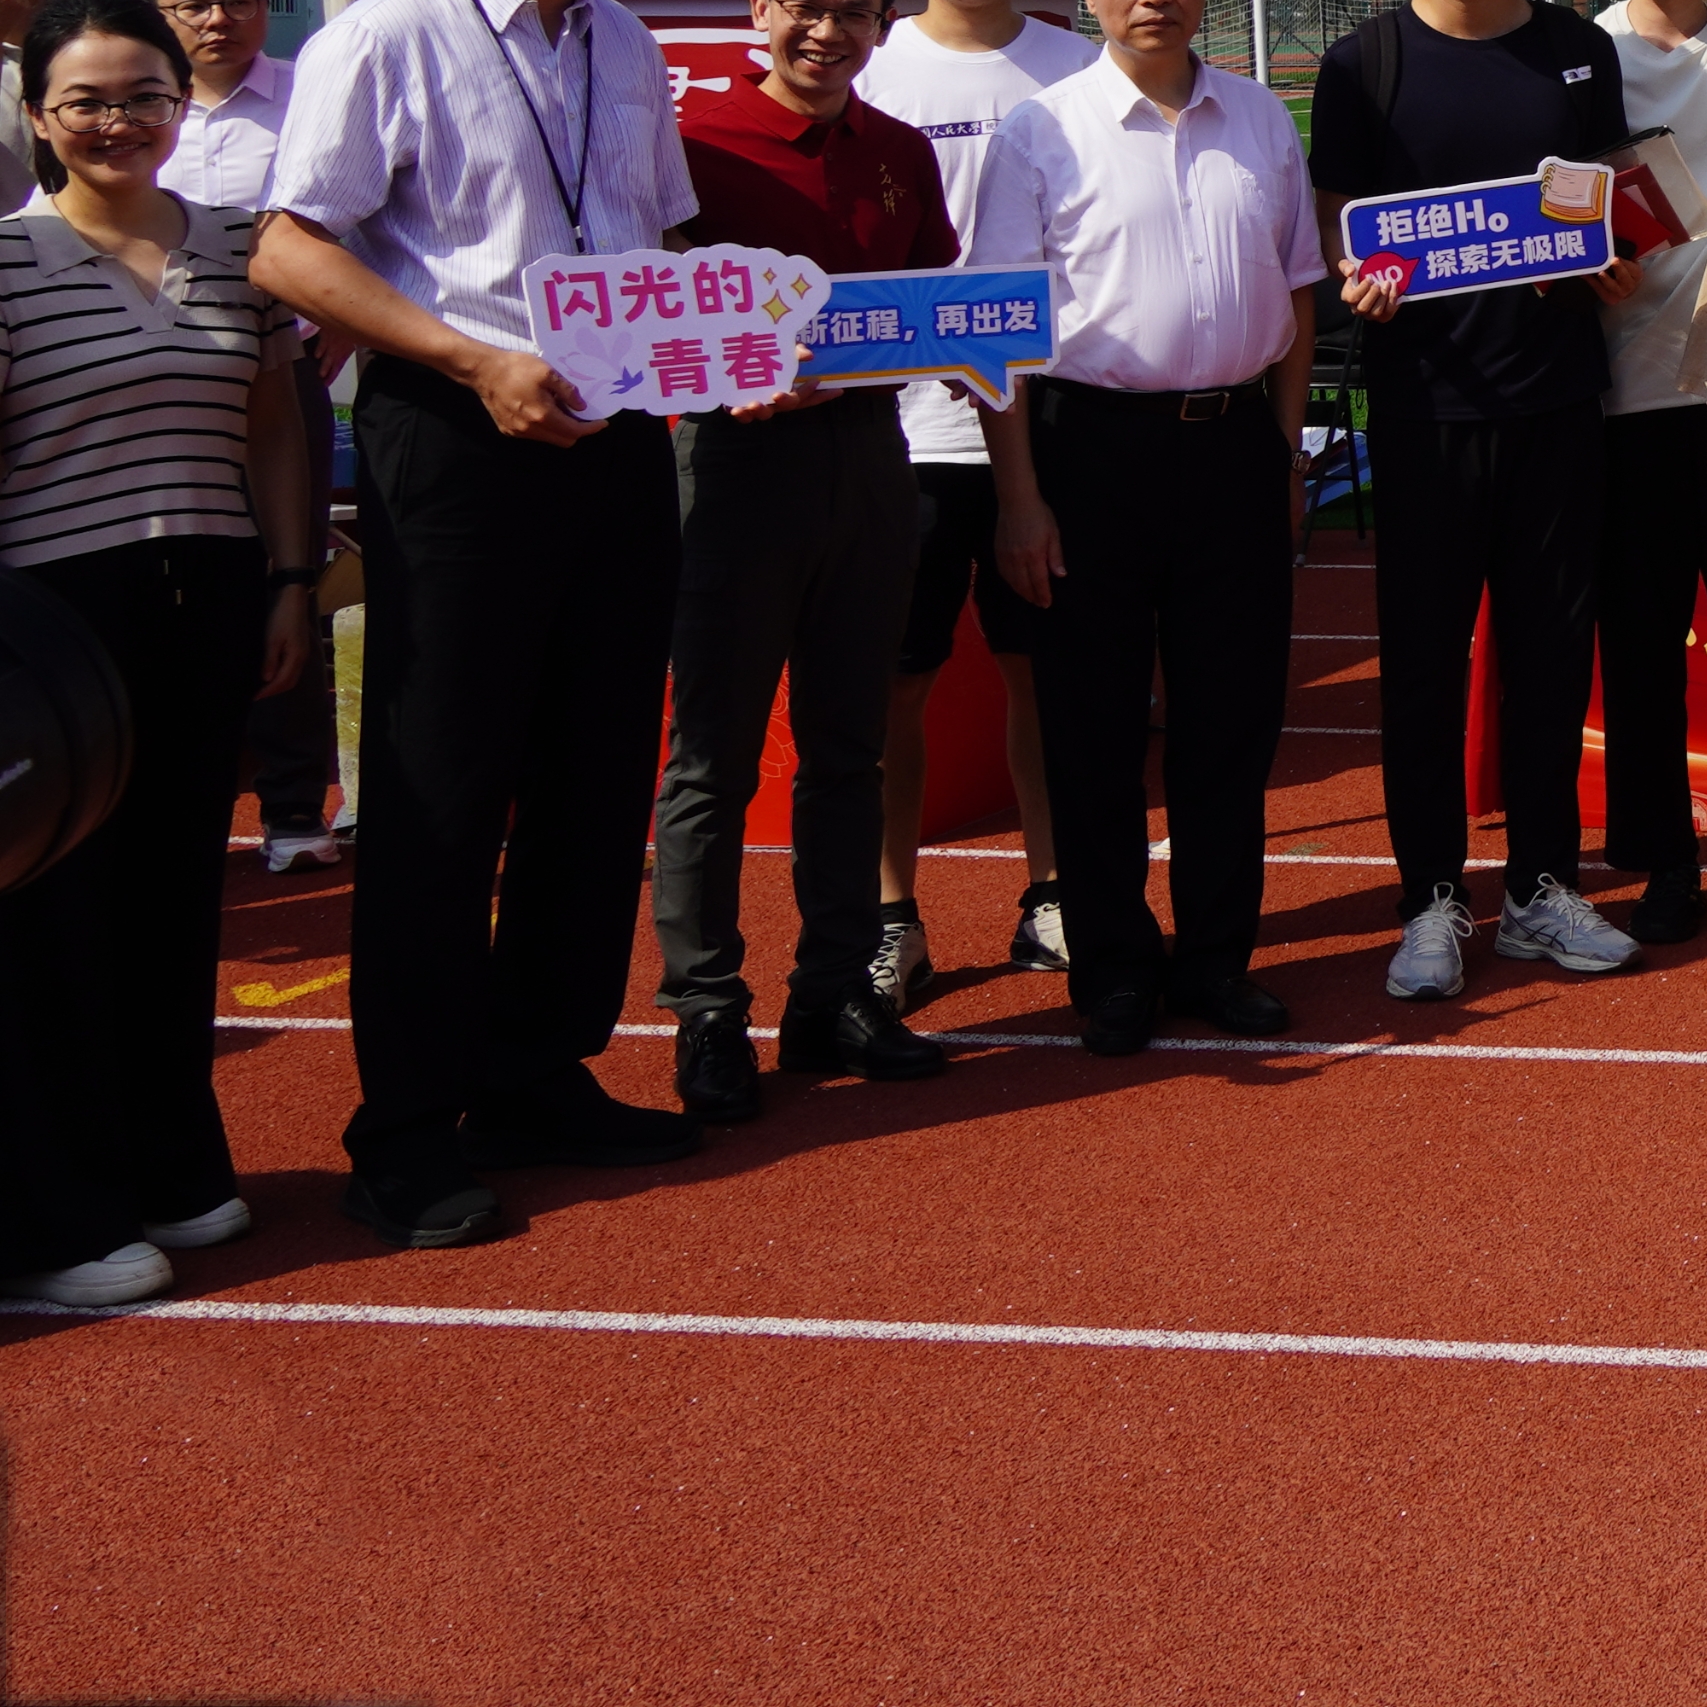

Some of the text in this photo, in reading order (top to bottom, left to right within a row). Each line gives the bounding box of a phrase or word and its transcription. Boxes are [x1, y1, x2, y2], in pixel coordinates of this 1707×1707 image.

[1426, 229, 1587, 281] 探索无极限
[543, 258, 753, 332] 闪光的
[648, 332, 784, 399] 青春
